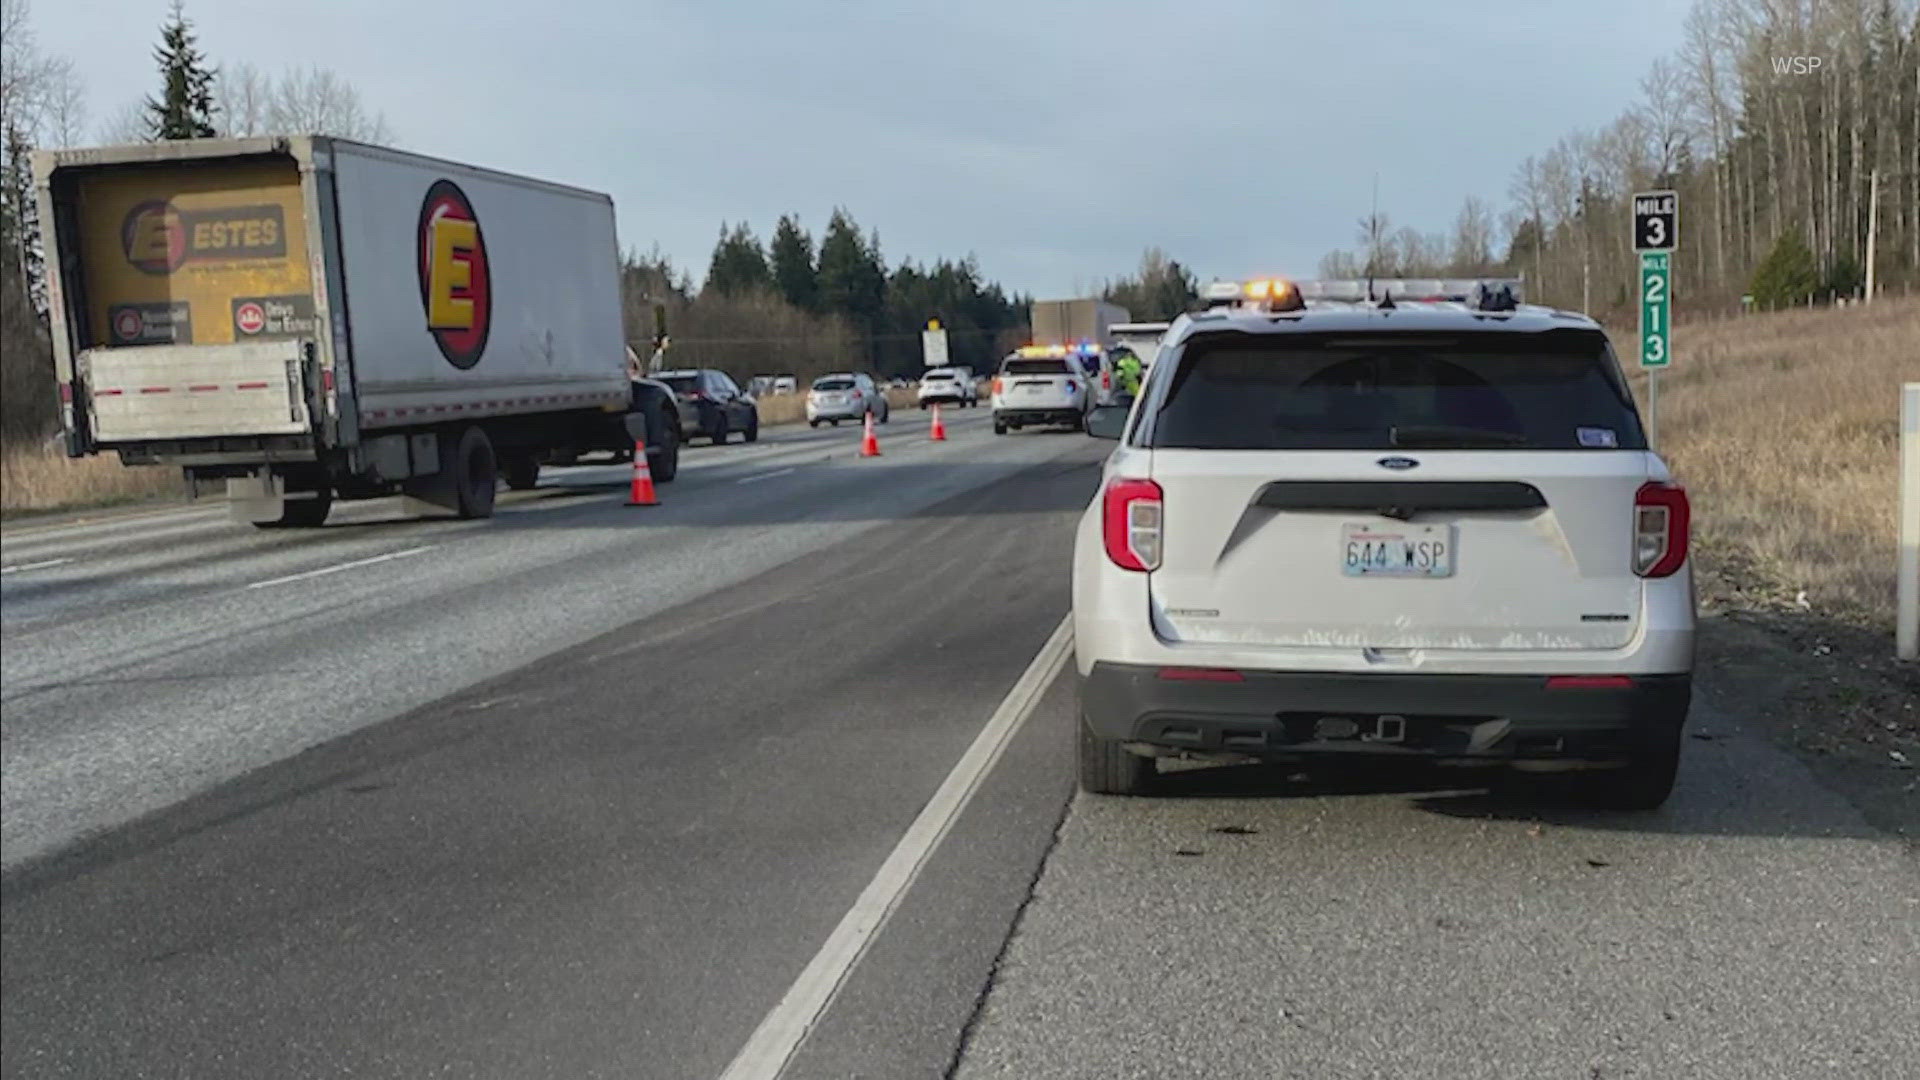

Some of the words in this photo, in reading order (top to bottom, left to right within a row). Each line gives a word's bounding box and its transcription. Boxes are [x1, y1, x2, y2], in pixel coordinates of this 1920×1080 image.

[1636, 199, 1674, 215] MILE
[193, 219, 279, 249] ESTES
[1645, 217, 1666, 246] 3
[429, 216, 477, 328] E
[1642, 257, 1668, 271] MILE
[1346, 541, 1387, 568] 644
[1403, 541, 1445, 568] WSP
